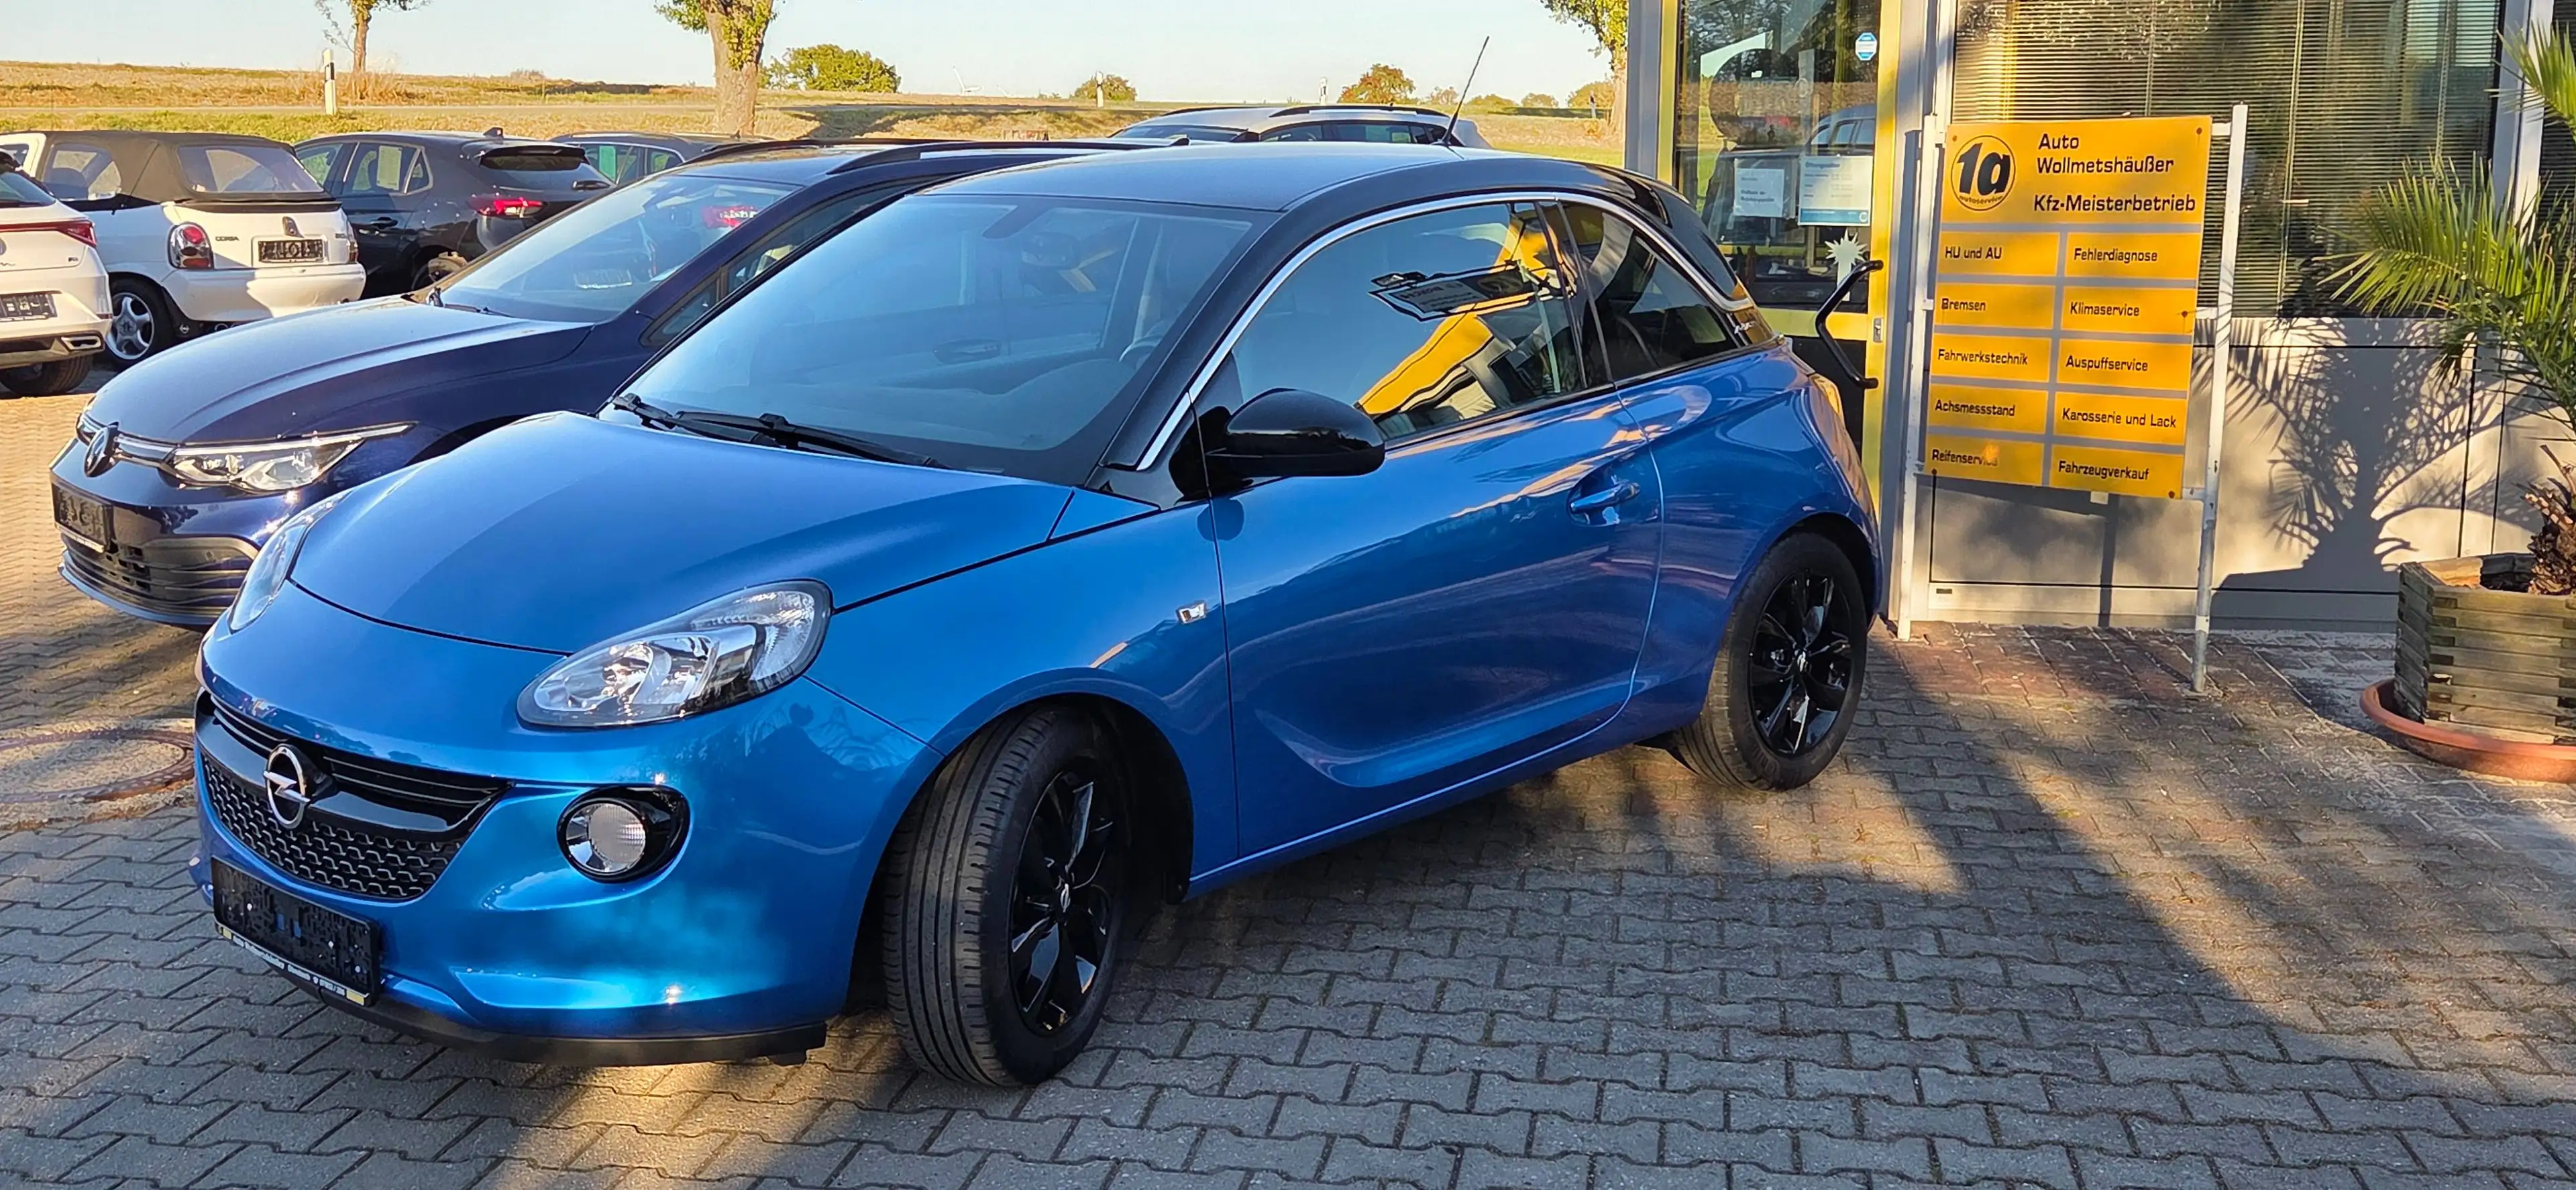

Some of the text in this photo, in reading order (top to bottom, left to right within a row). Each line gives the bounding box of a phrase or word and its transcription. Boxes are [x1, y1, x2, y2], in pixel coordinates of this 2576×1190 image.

[2038, 133, 2080, 150] Auto
[1956, 142, 2011, 197] 1a
[2037, 155, 2174, 174] Wollmetshäußer
[2034, 194, 2196, 213] Kfz-Meisterbetrieb
[1945, 246, 2002, 260] HU und AU
[2074, 248, 2158, 264] Fehlerdiagnose
[1941, 298, 1986, 311] Bremsen
[2070, 301, 2140, 317] Klimaservice
[1937, 348, 2029, 366] Fahrwerkstechnik
[2065, 355, 2148, 372] Auspuffservice
[1935, 398, 2016, 417] Achsmessstand
[2062, 407, 2177, 428] Karosserie und Lack
[2058, 459, 2149, 480] Fahrzeugverkauf
